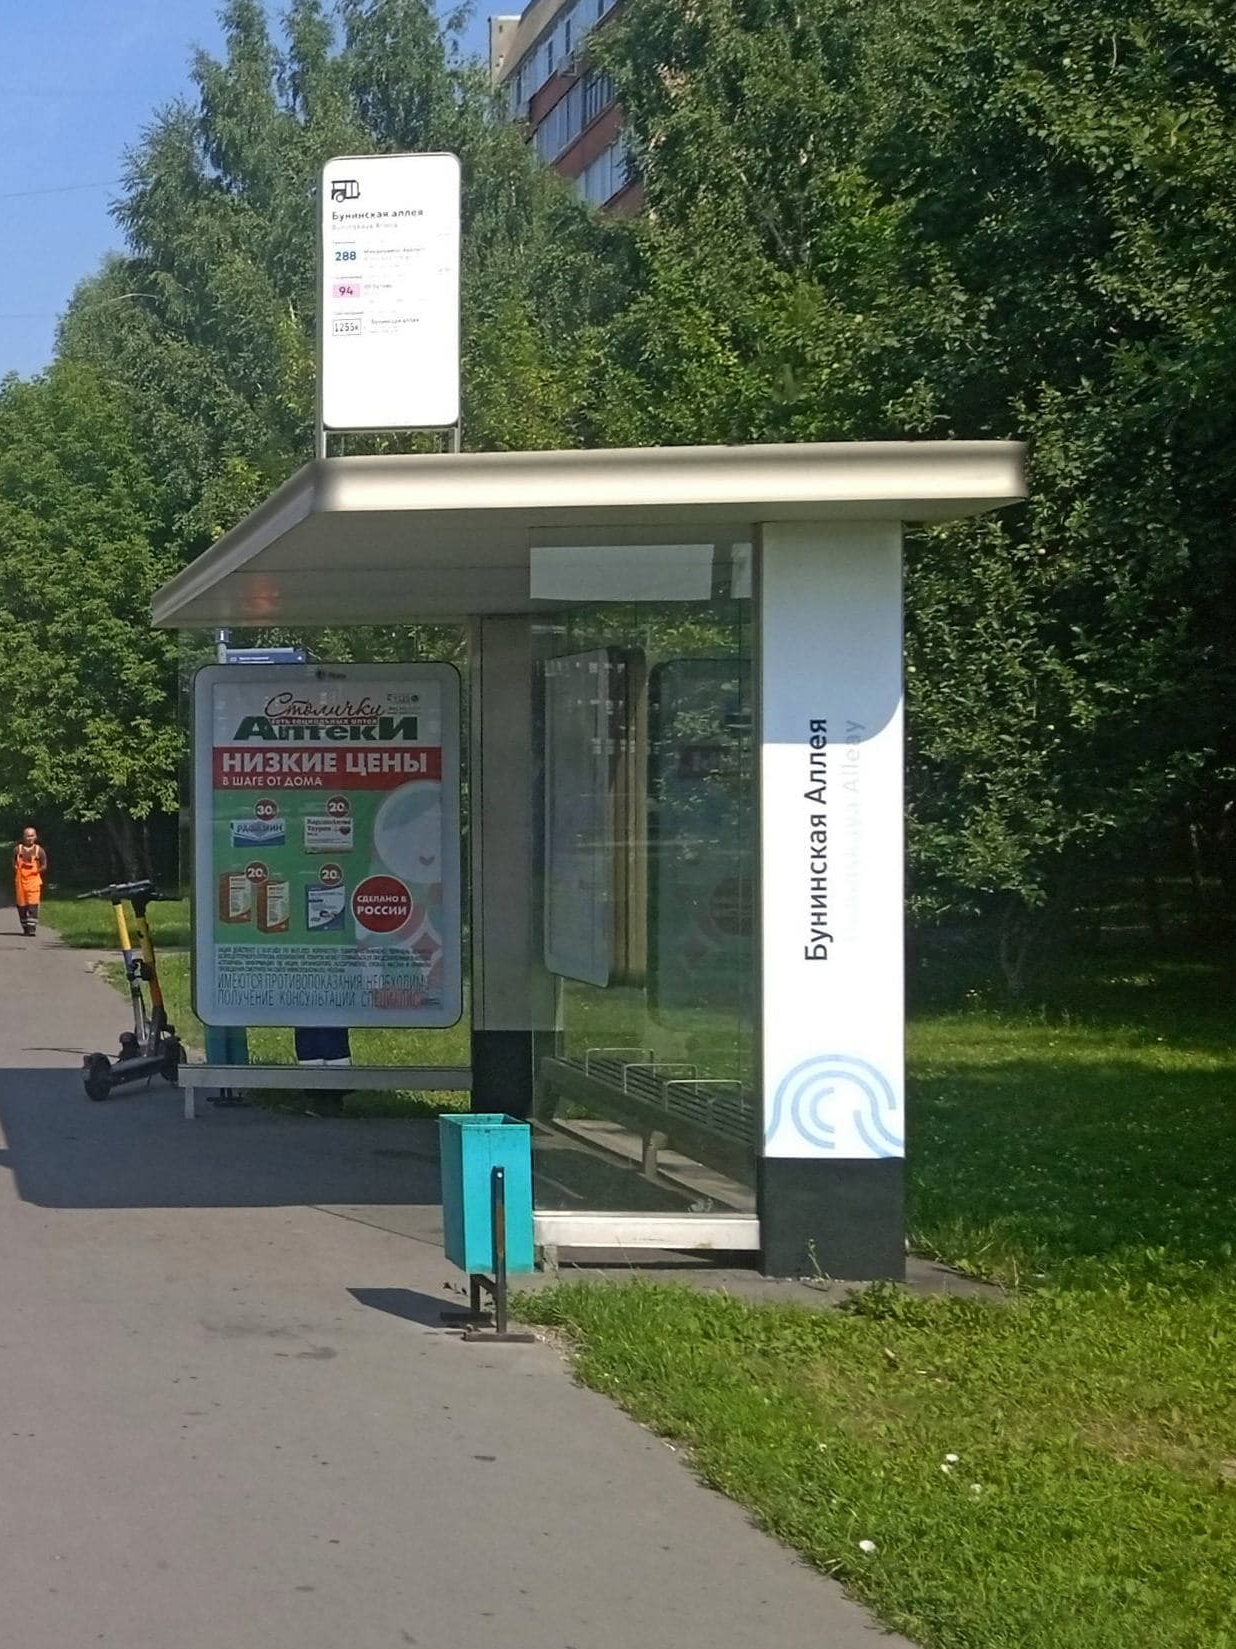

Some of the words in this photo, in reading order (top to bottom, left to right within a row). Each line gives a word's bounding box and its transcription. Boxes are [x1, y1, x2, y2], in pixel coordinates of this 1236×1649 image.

[332, 210, 389, 221] Бунинская
[391, 209, 424, 218] аллея
[335, 251, 357, 262] 288
[338, 285, 353, 297] 94
[264, 692, 385, 718] Столички
[222, 752, 337, 773] НИЗКИЕ
[346, 752, 427, 776] ЦЕНЫ
[804, 719, 828, 805] Аллея
[222, 777, 229, 786] В
[232, 777, 264, 786] ШАГЕ
[266, 777, 281, 786] ОТ
[284, 777, 322, 788] ДОМА
[804, 814, 834, 961] Бунинская
[356, 895, 399, 903] СДЕЛАНО
[356, 906, 407, 916] РОССИИ
[218, 974, 263, 990] ИМЕЮТСЯ
[217, 990, 274, 1007] ПОЛУЧЕНИЕ
[279, 990, 356, 1008] КОНСУЛЬТАЦИИ
